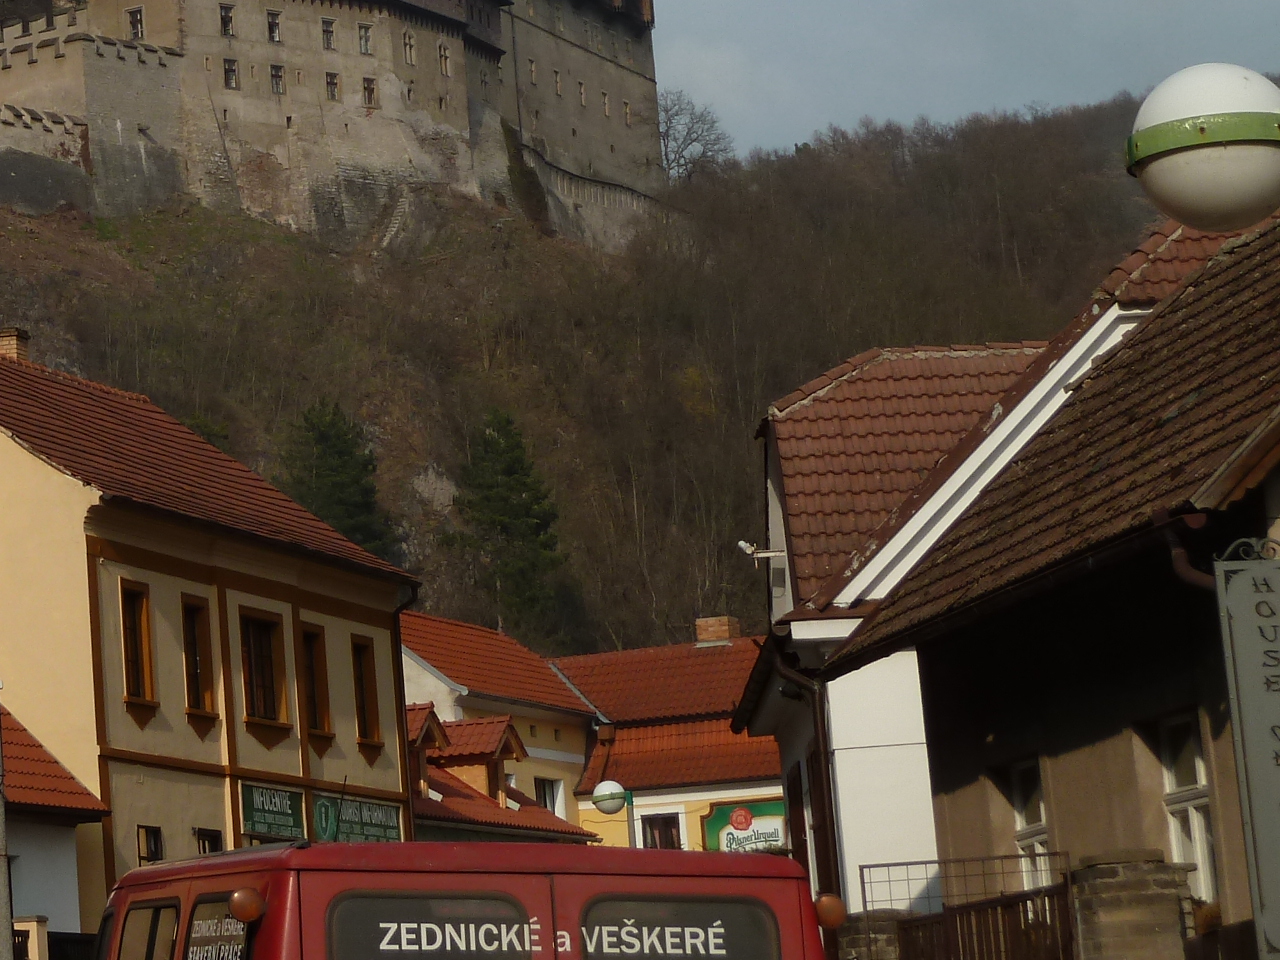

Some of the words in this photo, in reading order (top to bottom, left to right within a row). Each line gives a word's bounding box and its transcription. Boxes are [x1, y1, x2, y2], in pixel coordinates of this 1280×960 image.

[252, 787, 292, 814] INFOCENTRE
[361, 802, 398, 827] INFORMATION
[726, 832, 754, 851] Pilsner
[752, 828, 780, 843] Urquell
[379, 917, 542, 951] ZEDNICKÉ
[553, 926, 571, 952] a
[581, 918, 727, 955] VEŠKERÉ
